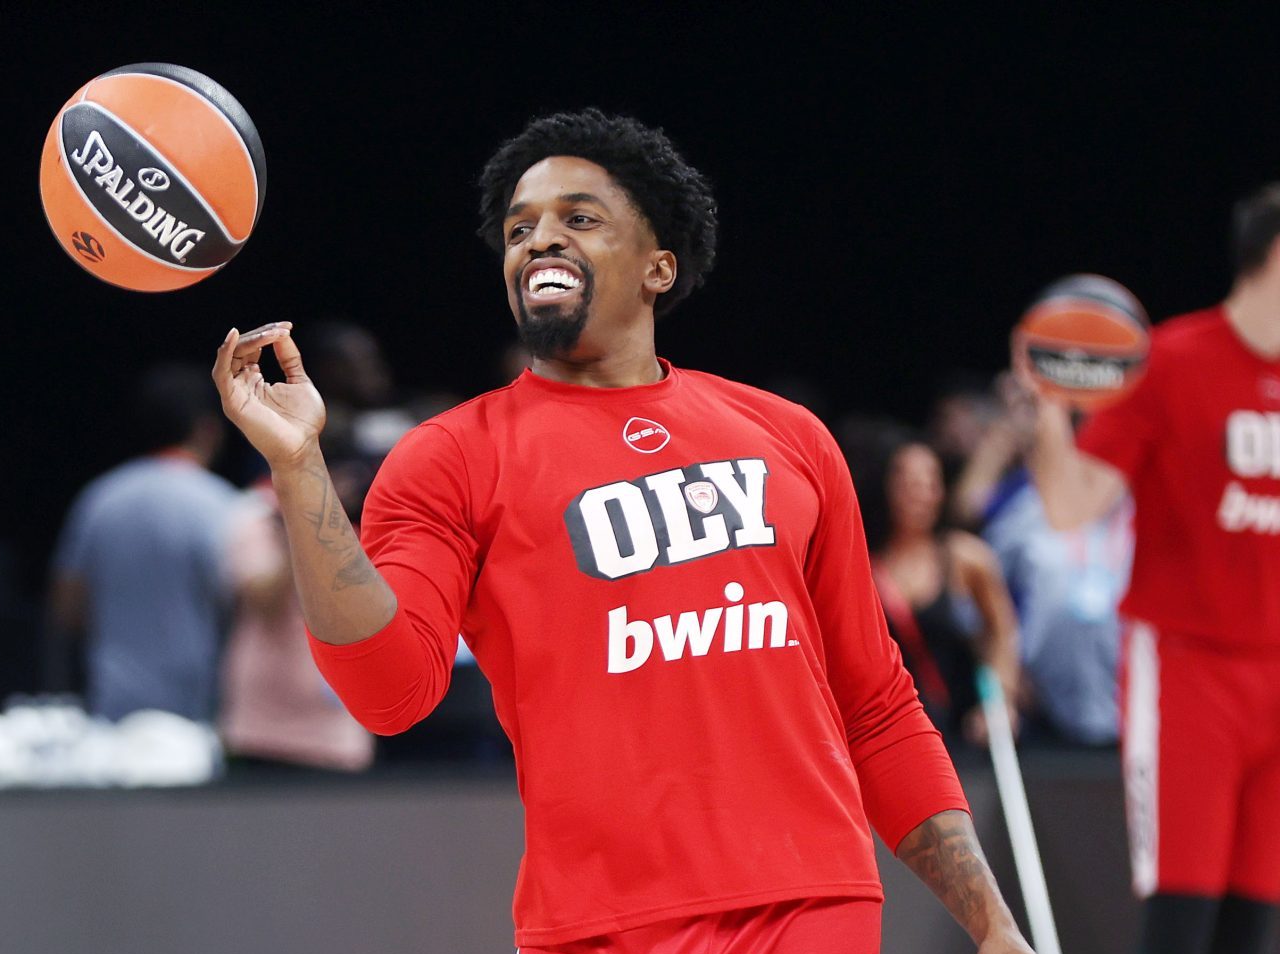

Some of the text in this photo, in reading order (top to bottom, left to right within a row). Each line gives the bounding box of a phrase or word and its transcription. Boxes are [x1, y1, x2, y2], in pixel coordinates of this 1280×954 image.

[71, 130, 206, 260] SPALDING
[627, 427, 666, 442] GSA
[577, 458, 776, 579] OLY
[607, 581, 789, 674] bwin
